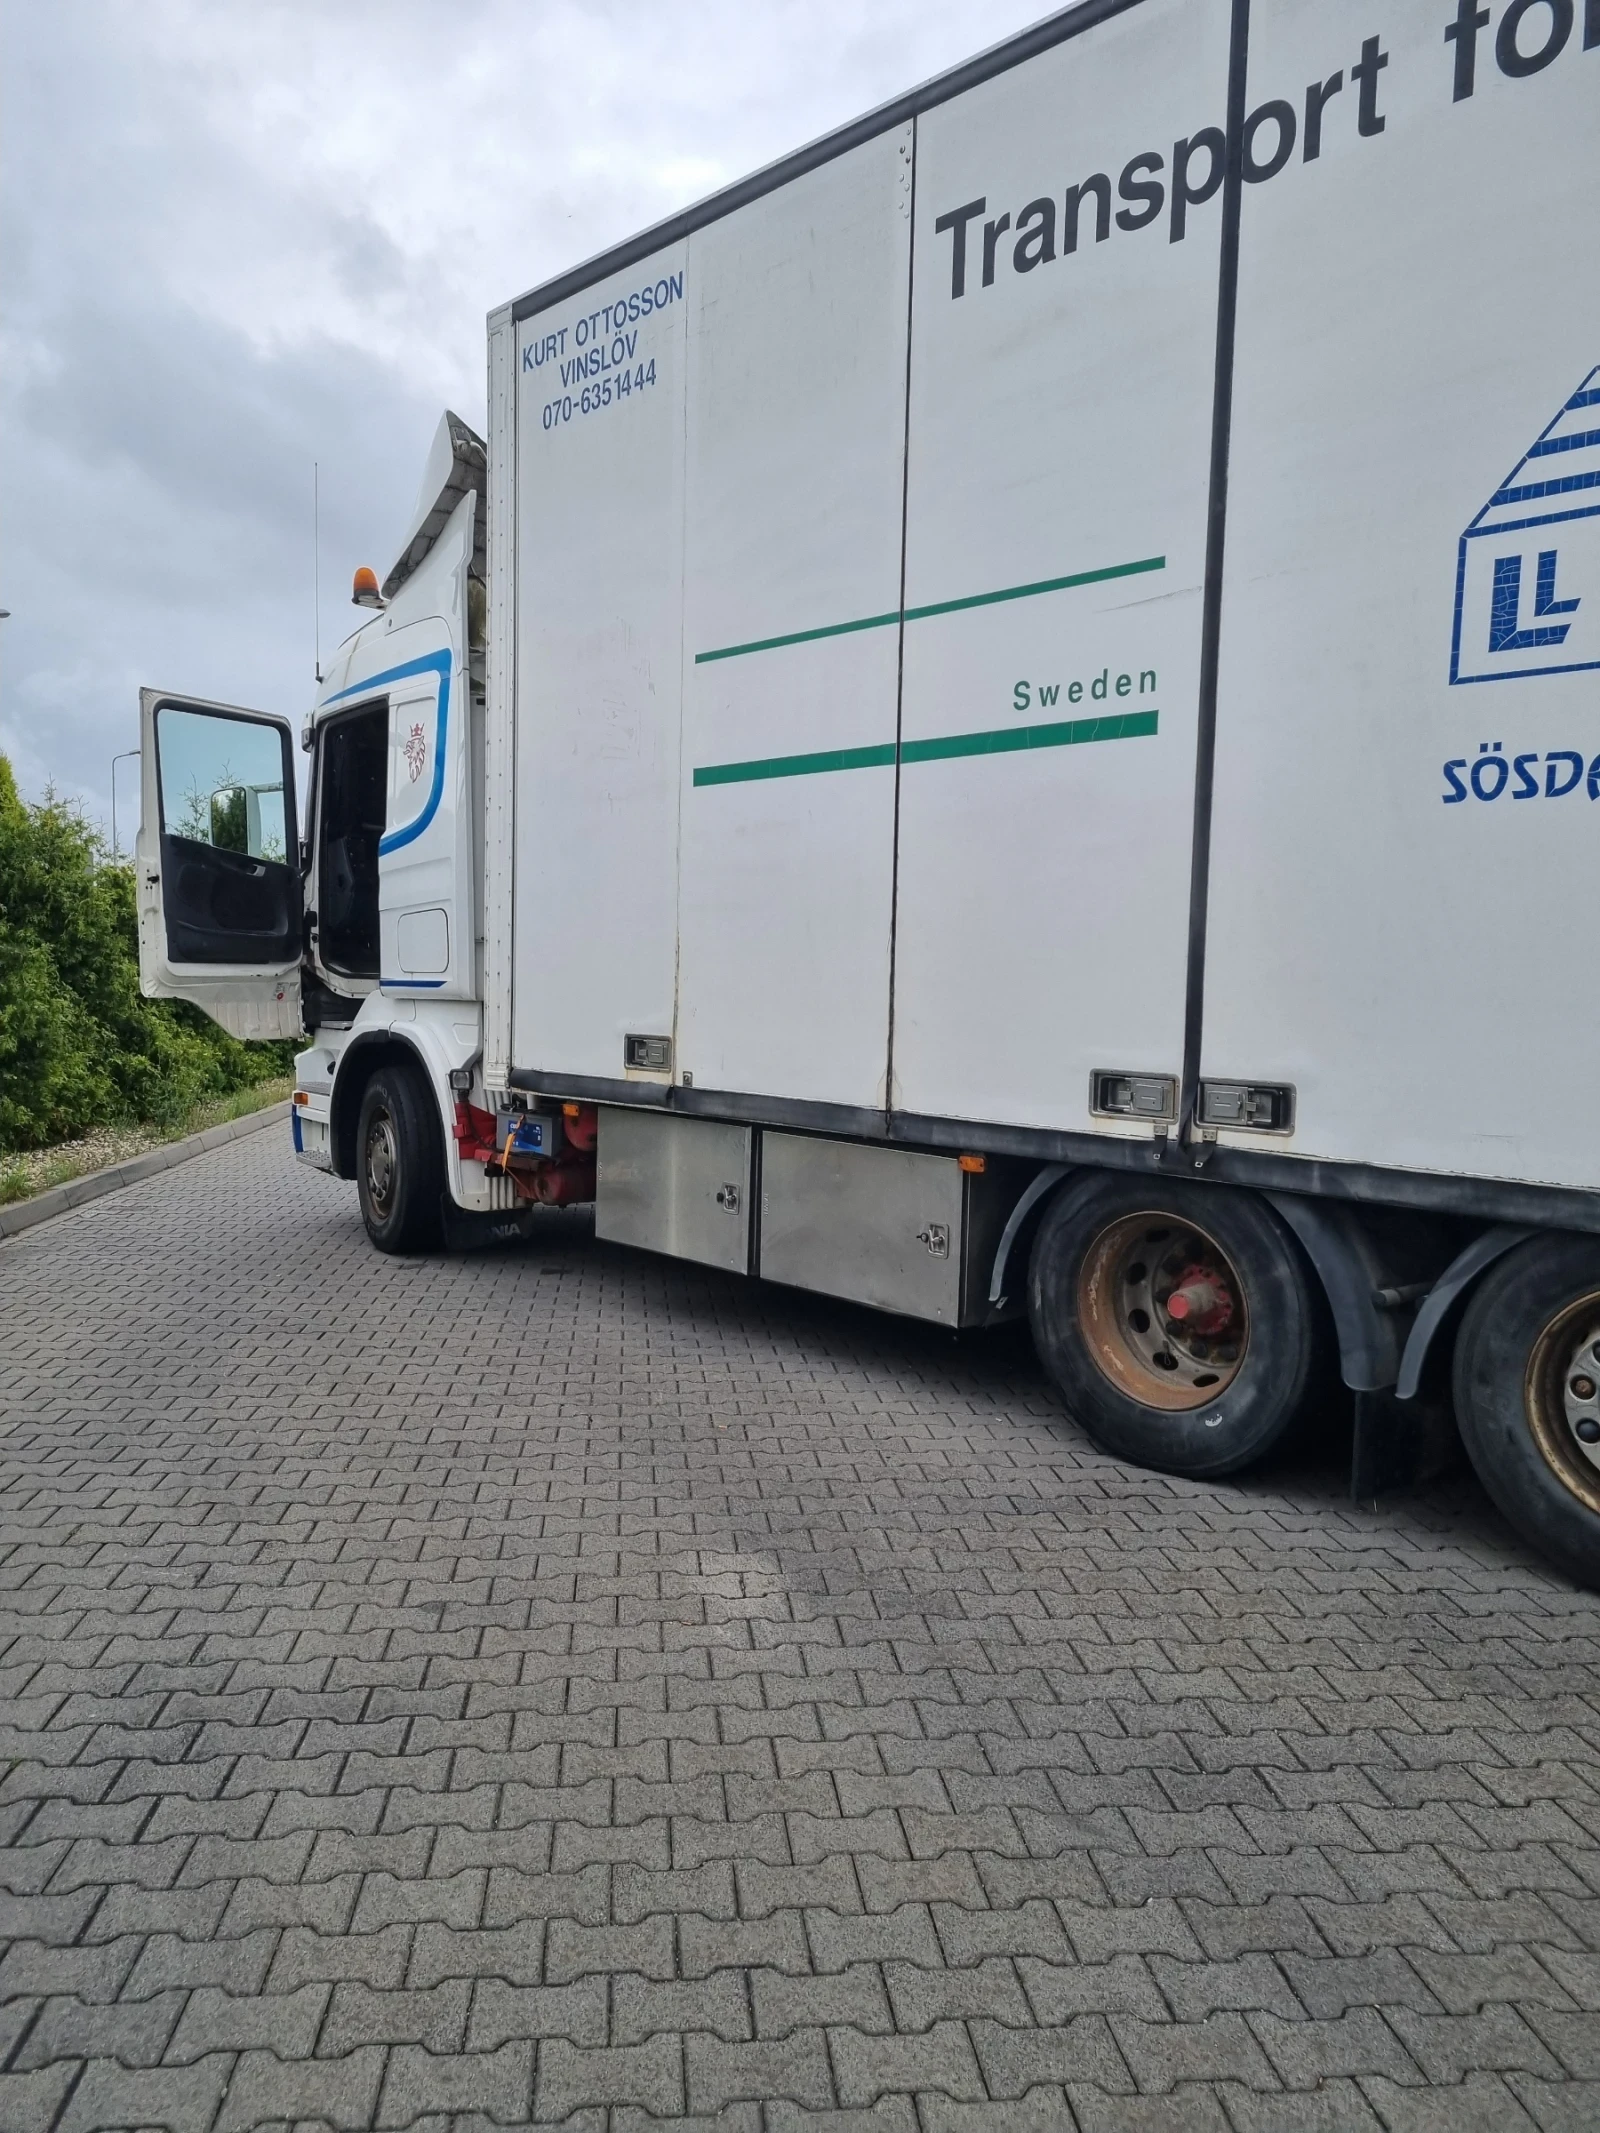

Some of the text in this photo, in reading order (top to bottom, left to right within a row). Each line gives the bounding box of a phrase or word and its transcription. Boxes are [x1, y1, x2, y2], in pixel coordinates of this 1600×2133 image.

[935, 34, 1389, 300] Transport
[522, 271, 683, 373] KURT OTTOSSON
[560, 330, 638, 388] VINSLÖV
[1013, 668, 1157, 711] Sweden
